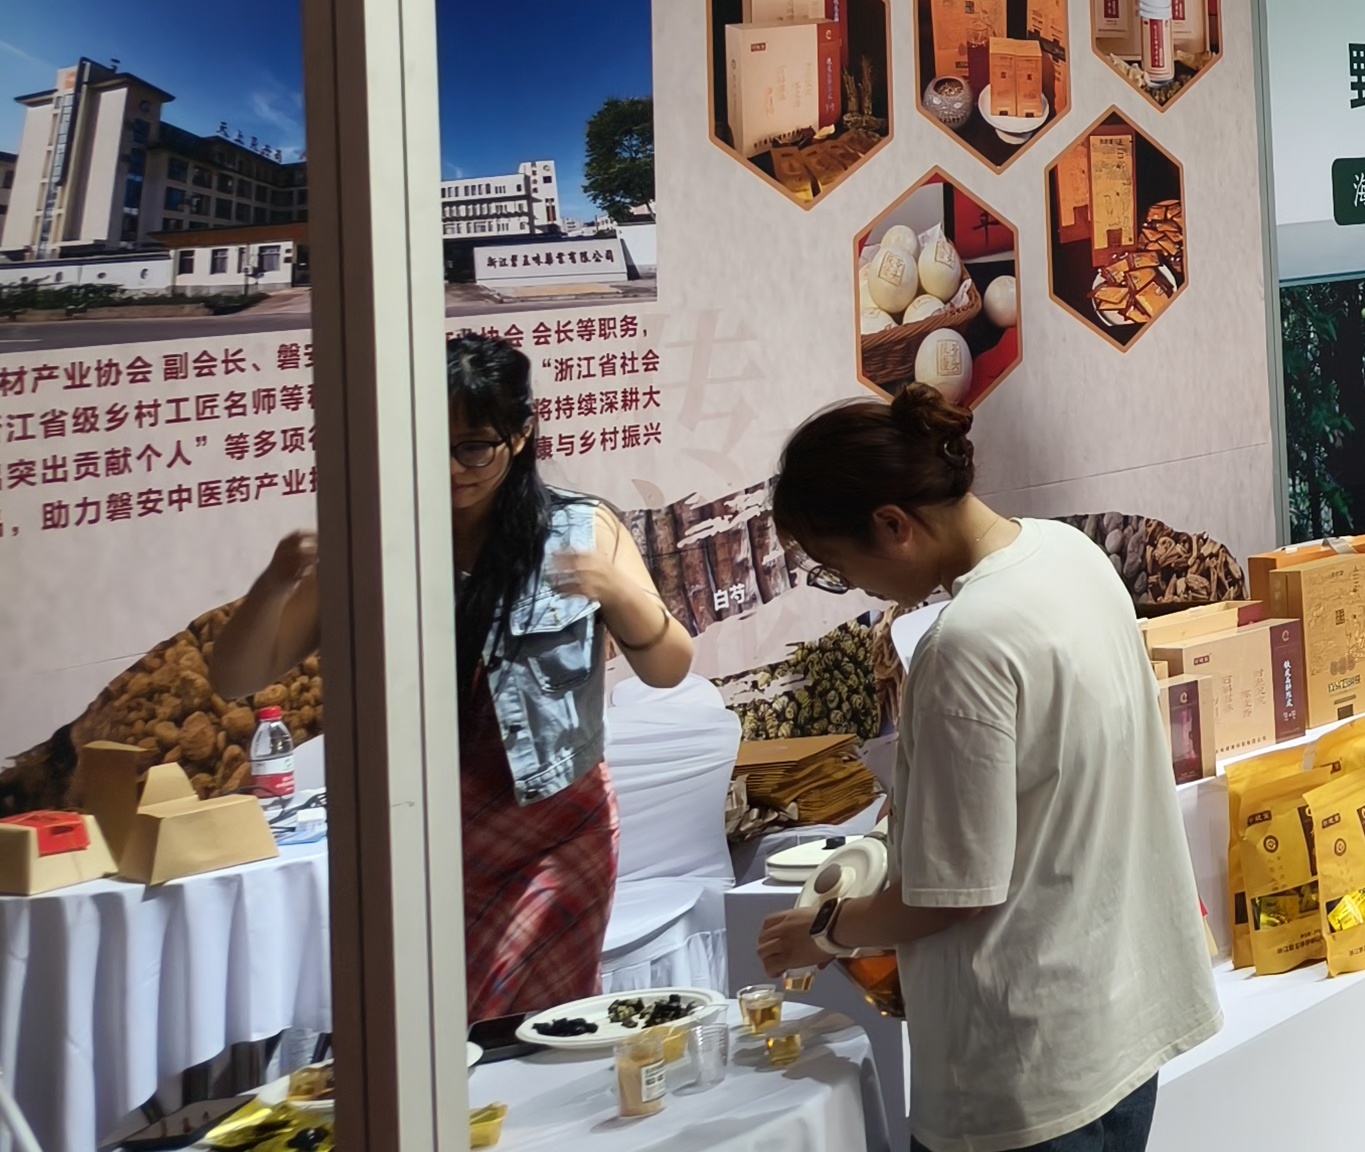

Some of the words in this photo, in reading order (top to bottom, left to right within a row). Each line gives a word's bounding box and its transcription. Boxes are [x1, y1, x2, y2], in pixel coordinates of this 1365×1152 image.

[0, 384, 315, 443] 江省级乡村工匠名师等
[0, 425, 316, 491] 突出贡献个人”等多项
[713, 583, 746, 612] 白芍
